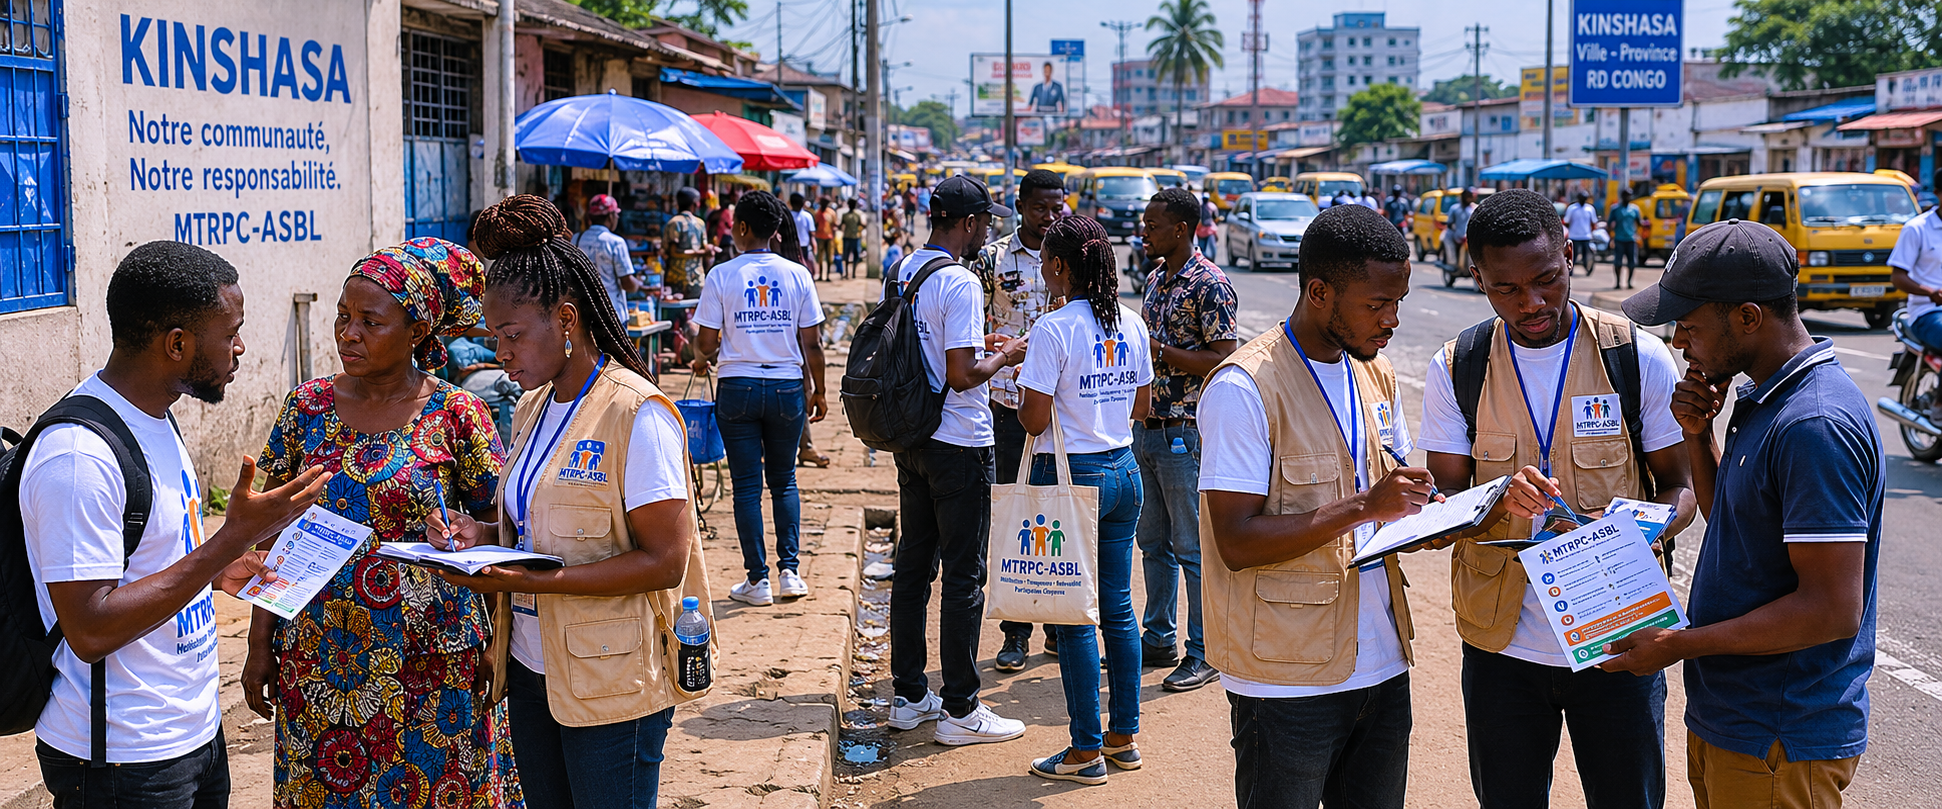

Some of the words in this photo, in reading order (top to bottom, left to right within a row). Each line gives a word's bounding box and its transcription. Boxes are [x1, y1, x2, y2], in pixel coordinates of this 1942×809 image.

[1577, 13, 1678, 36] KINSHASA
[120, 13, 352, 104] KINSHASA
[1620, 42, 1678, 62] Province
[1586, 69, 1609, 89] RD
[1611, 69, 1667, 89] CONGO
[128, 109, 193, 145] Notre
[201, 121, 330, 154] communauté,
[130, 158, 193, 191] Notre
[203, 160, 341, 199] responsabilité.
[174, 210, 322, 245] MTRPC-ASBL
[734, 310, 792, 323] MTRPC-ASBL
[1552, 523, 1620, 558] MTRPC-ASBL
[1001, 558, 1082, 576] MTRPC-ASBL
